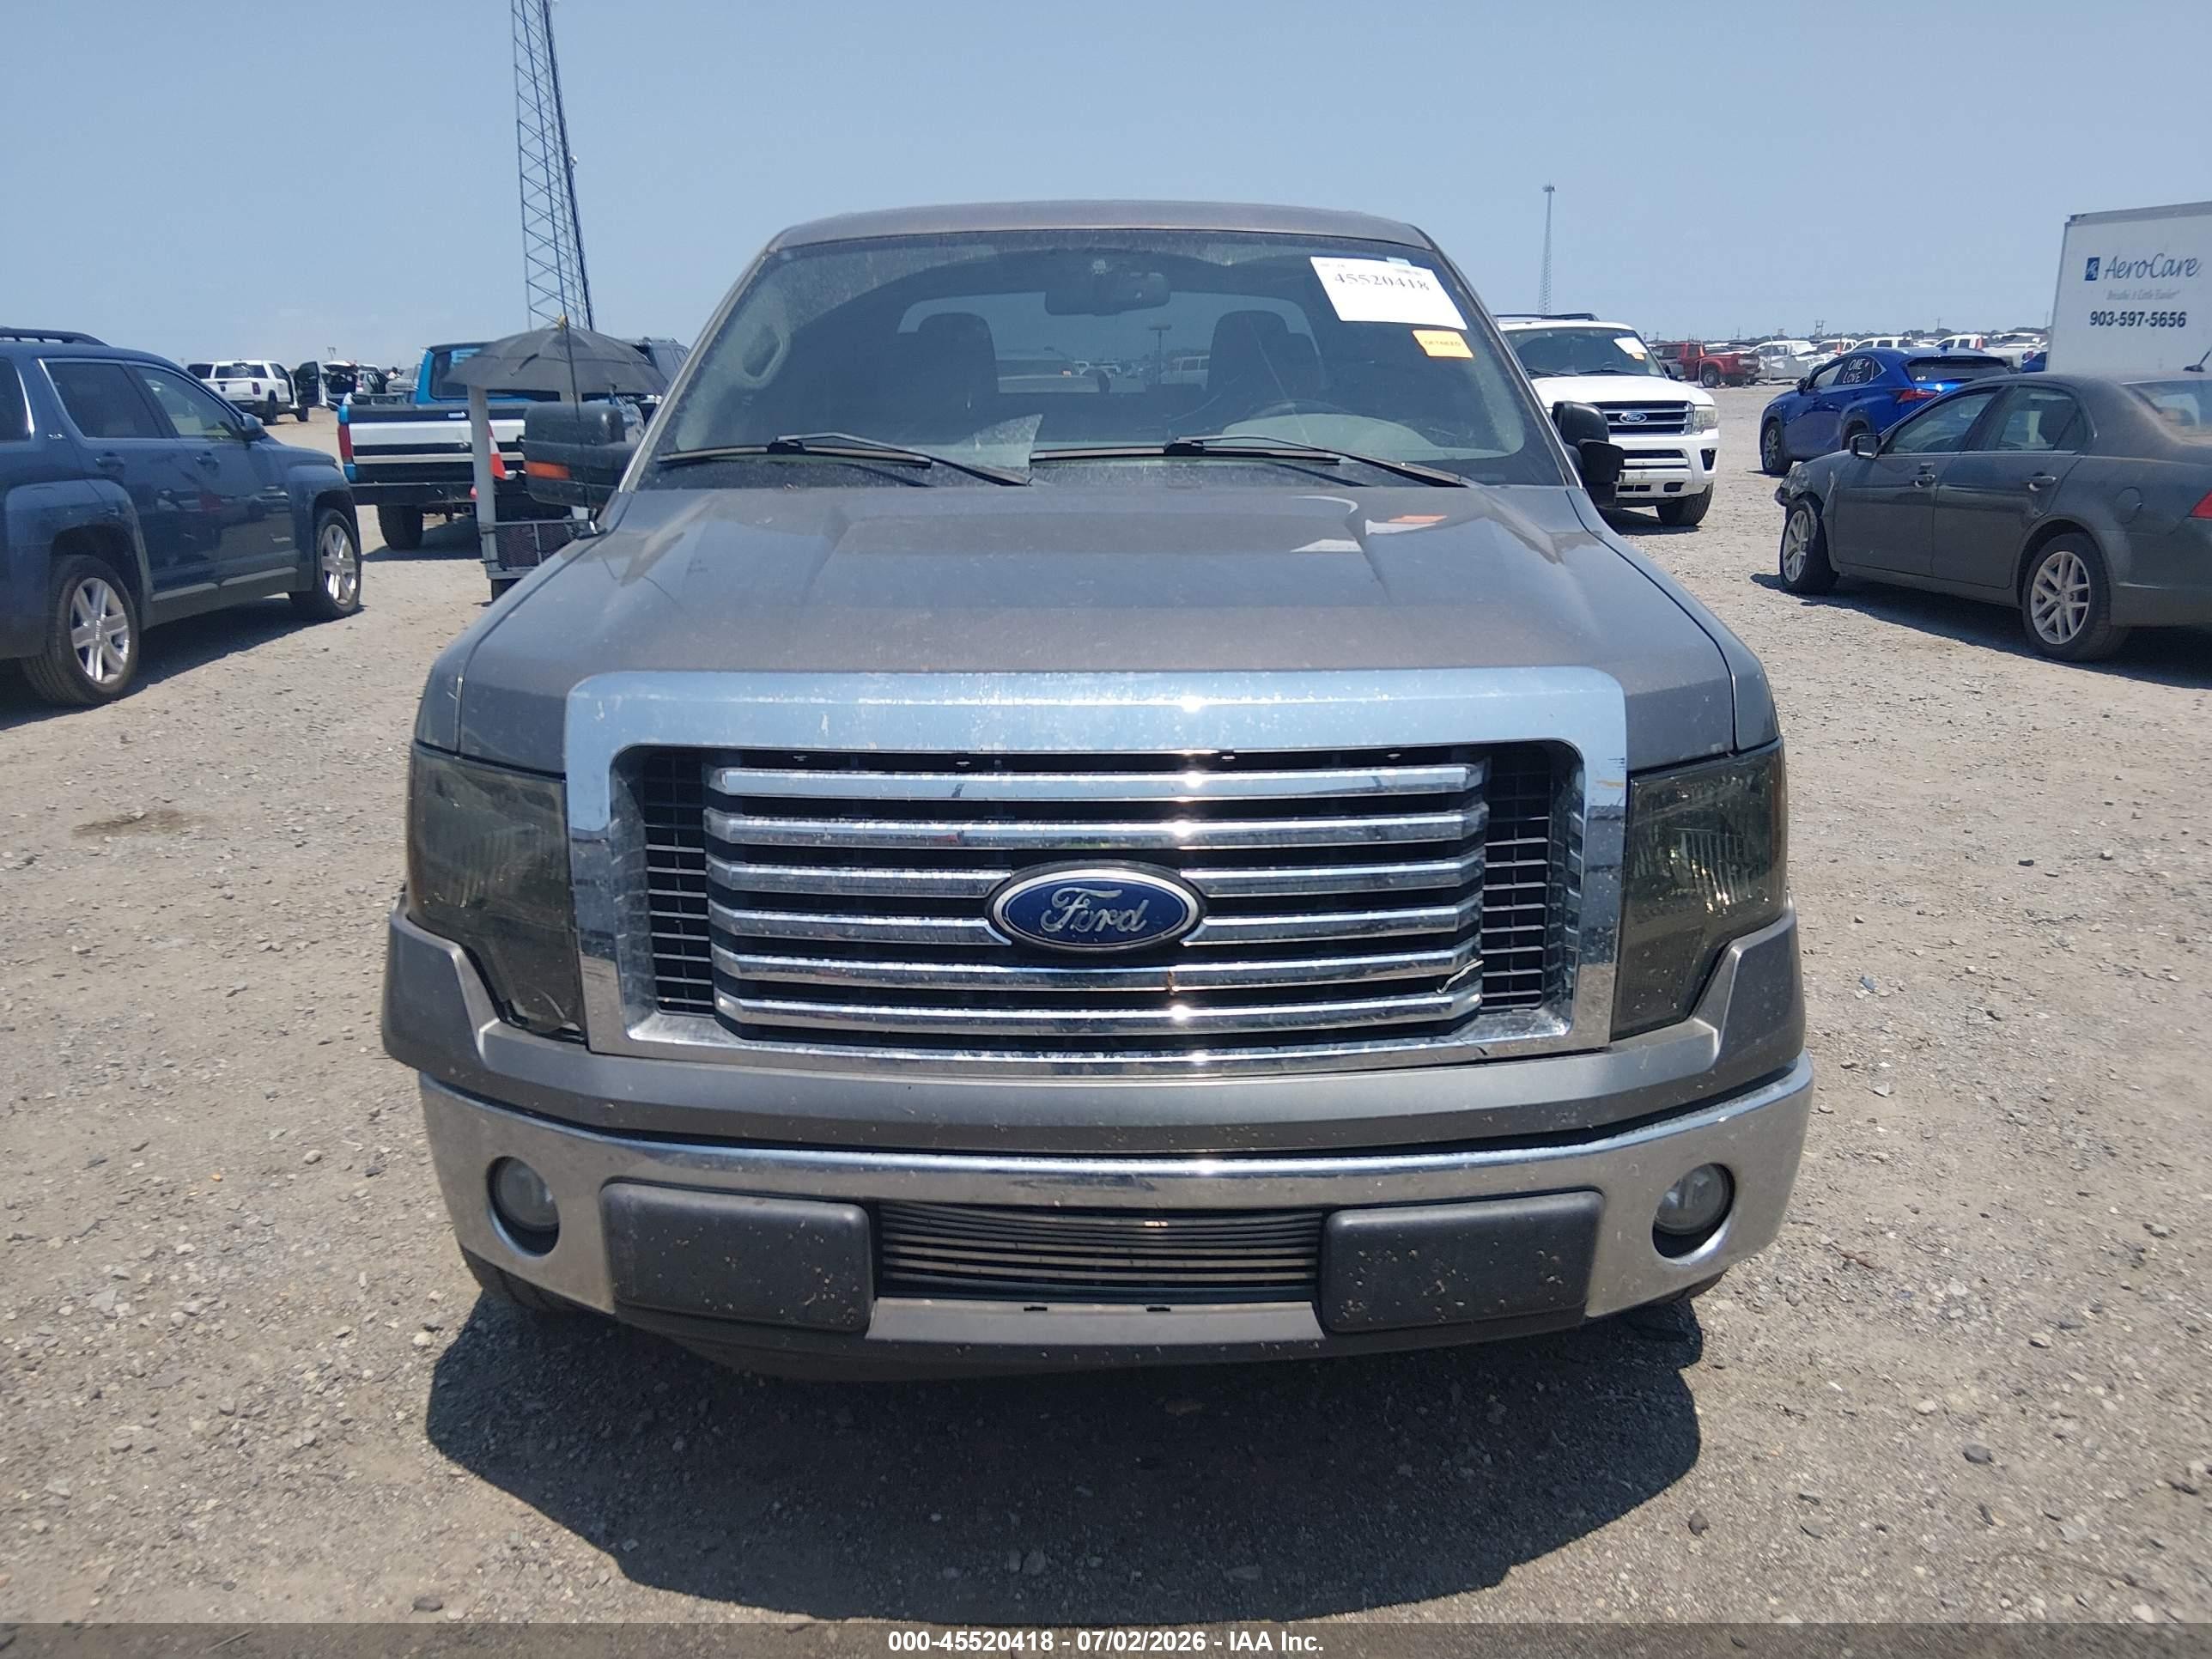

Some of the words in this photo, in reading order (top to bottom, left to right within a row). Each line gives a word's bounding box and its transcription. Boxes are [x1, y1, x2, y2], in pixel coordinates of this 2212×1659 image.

[2104, 252, 2203, 280] AeroCare
[1334, 272, 1430, 291] 45520418
[2089, 310, 2187, 328] 903-597-5656
[1848, 358, 1866, 371] ONE
[1842, 372, 1863, 384] LOVE
[1040, 887, 1150, 933] Ford
